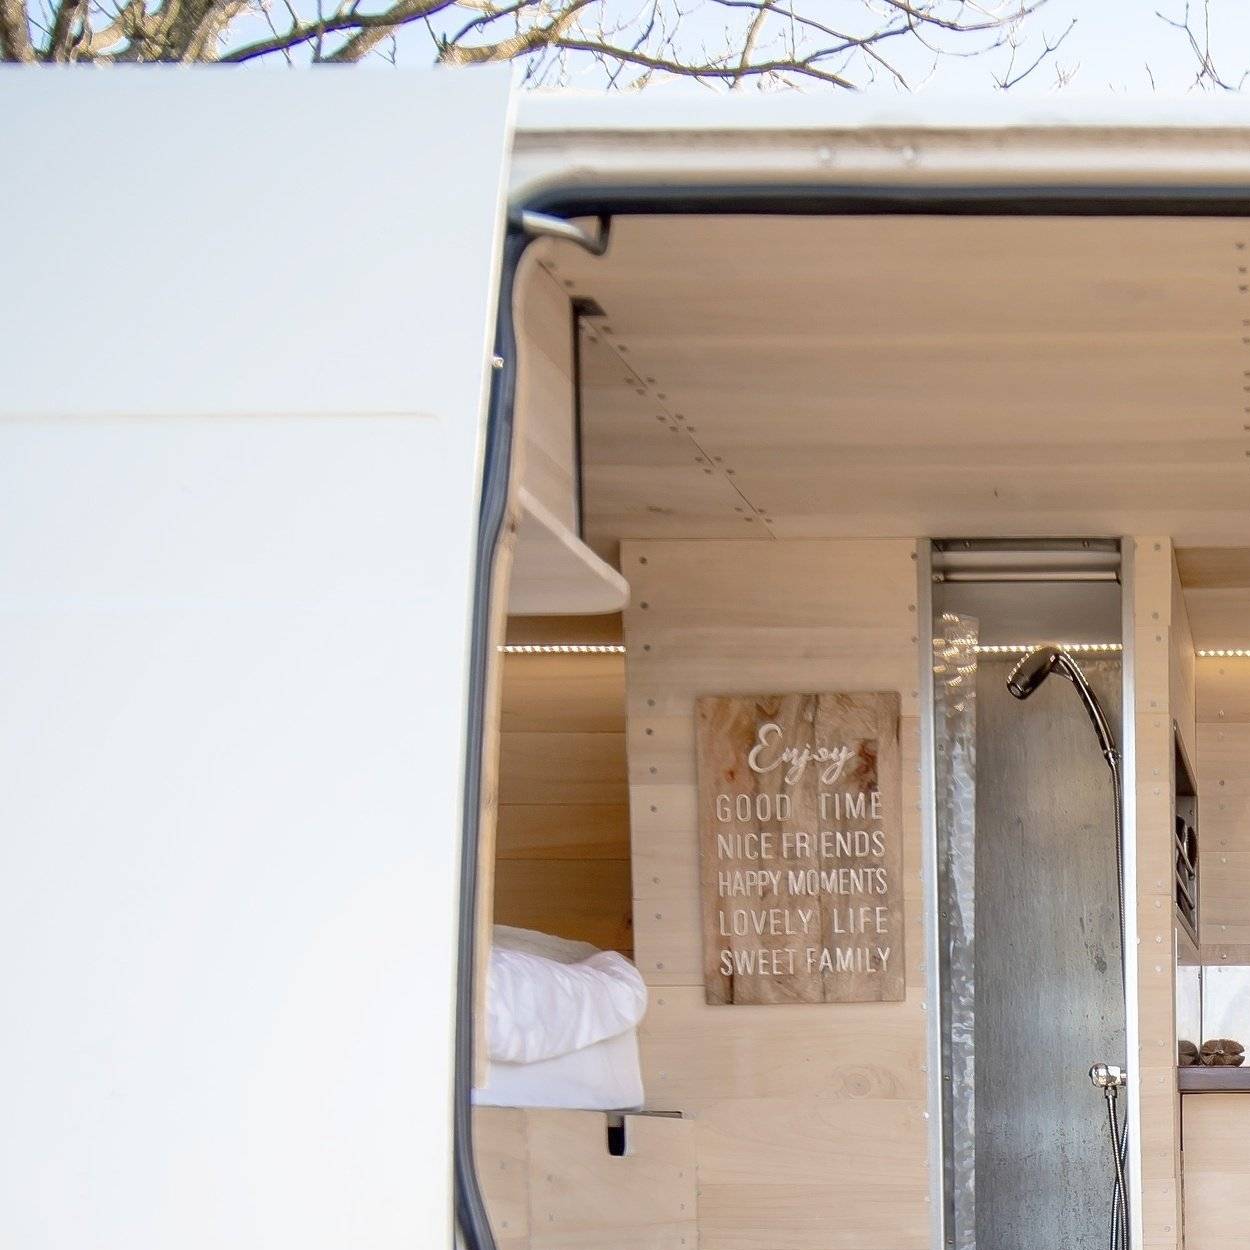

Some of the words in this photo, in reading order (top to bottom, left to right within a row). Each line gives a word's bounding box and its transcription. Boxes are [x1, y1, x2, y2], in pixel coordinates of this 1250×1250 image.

[749, 723, 856, 785] Enjoy
[716, 793, 792, 822] GOOD
[819, 791, 883, 820] TIME
[717, 832, 774, 860] NICE
[783, 830, 886, 858] FRIENDS
[719, 869, 781, 897] HAPPY
[788, 867, 888, 896] MOMENTS
[719, 908, 813, 937] LOVELY
[833, 906, 889, 934] LIFE
[720, 948, 797, 976] SWEET
[806, 946, 891, 975] FAMILY
